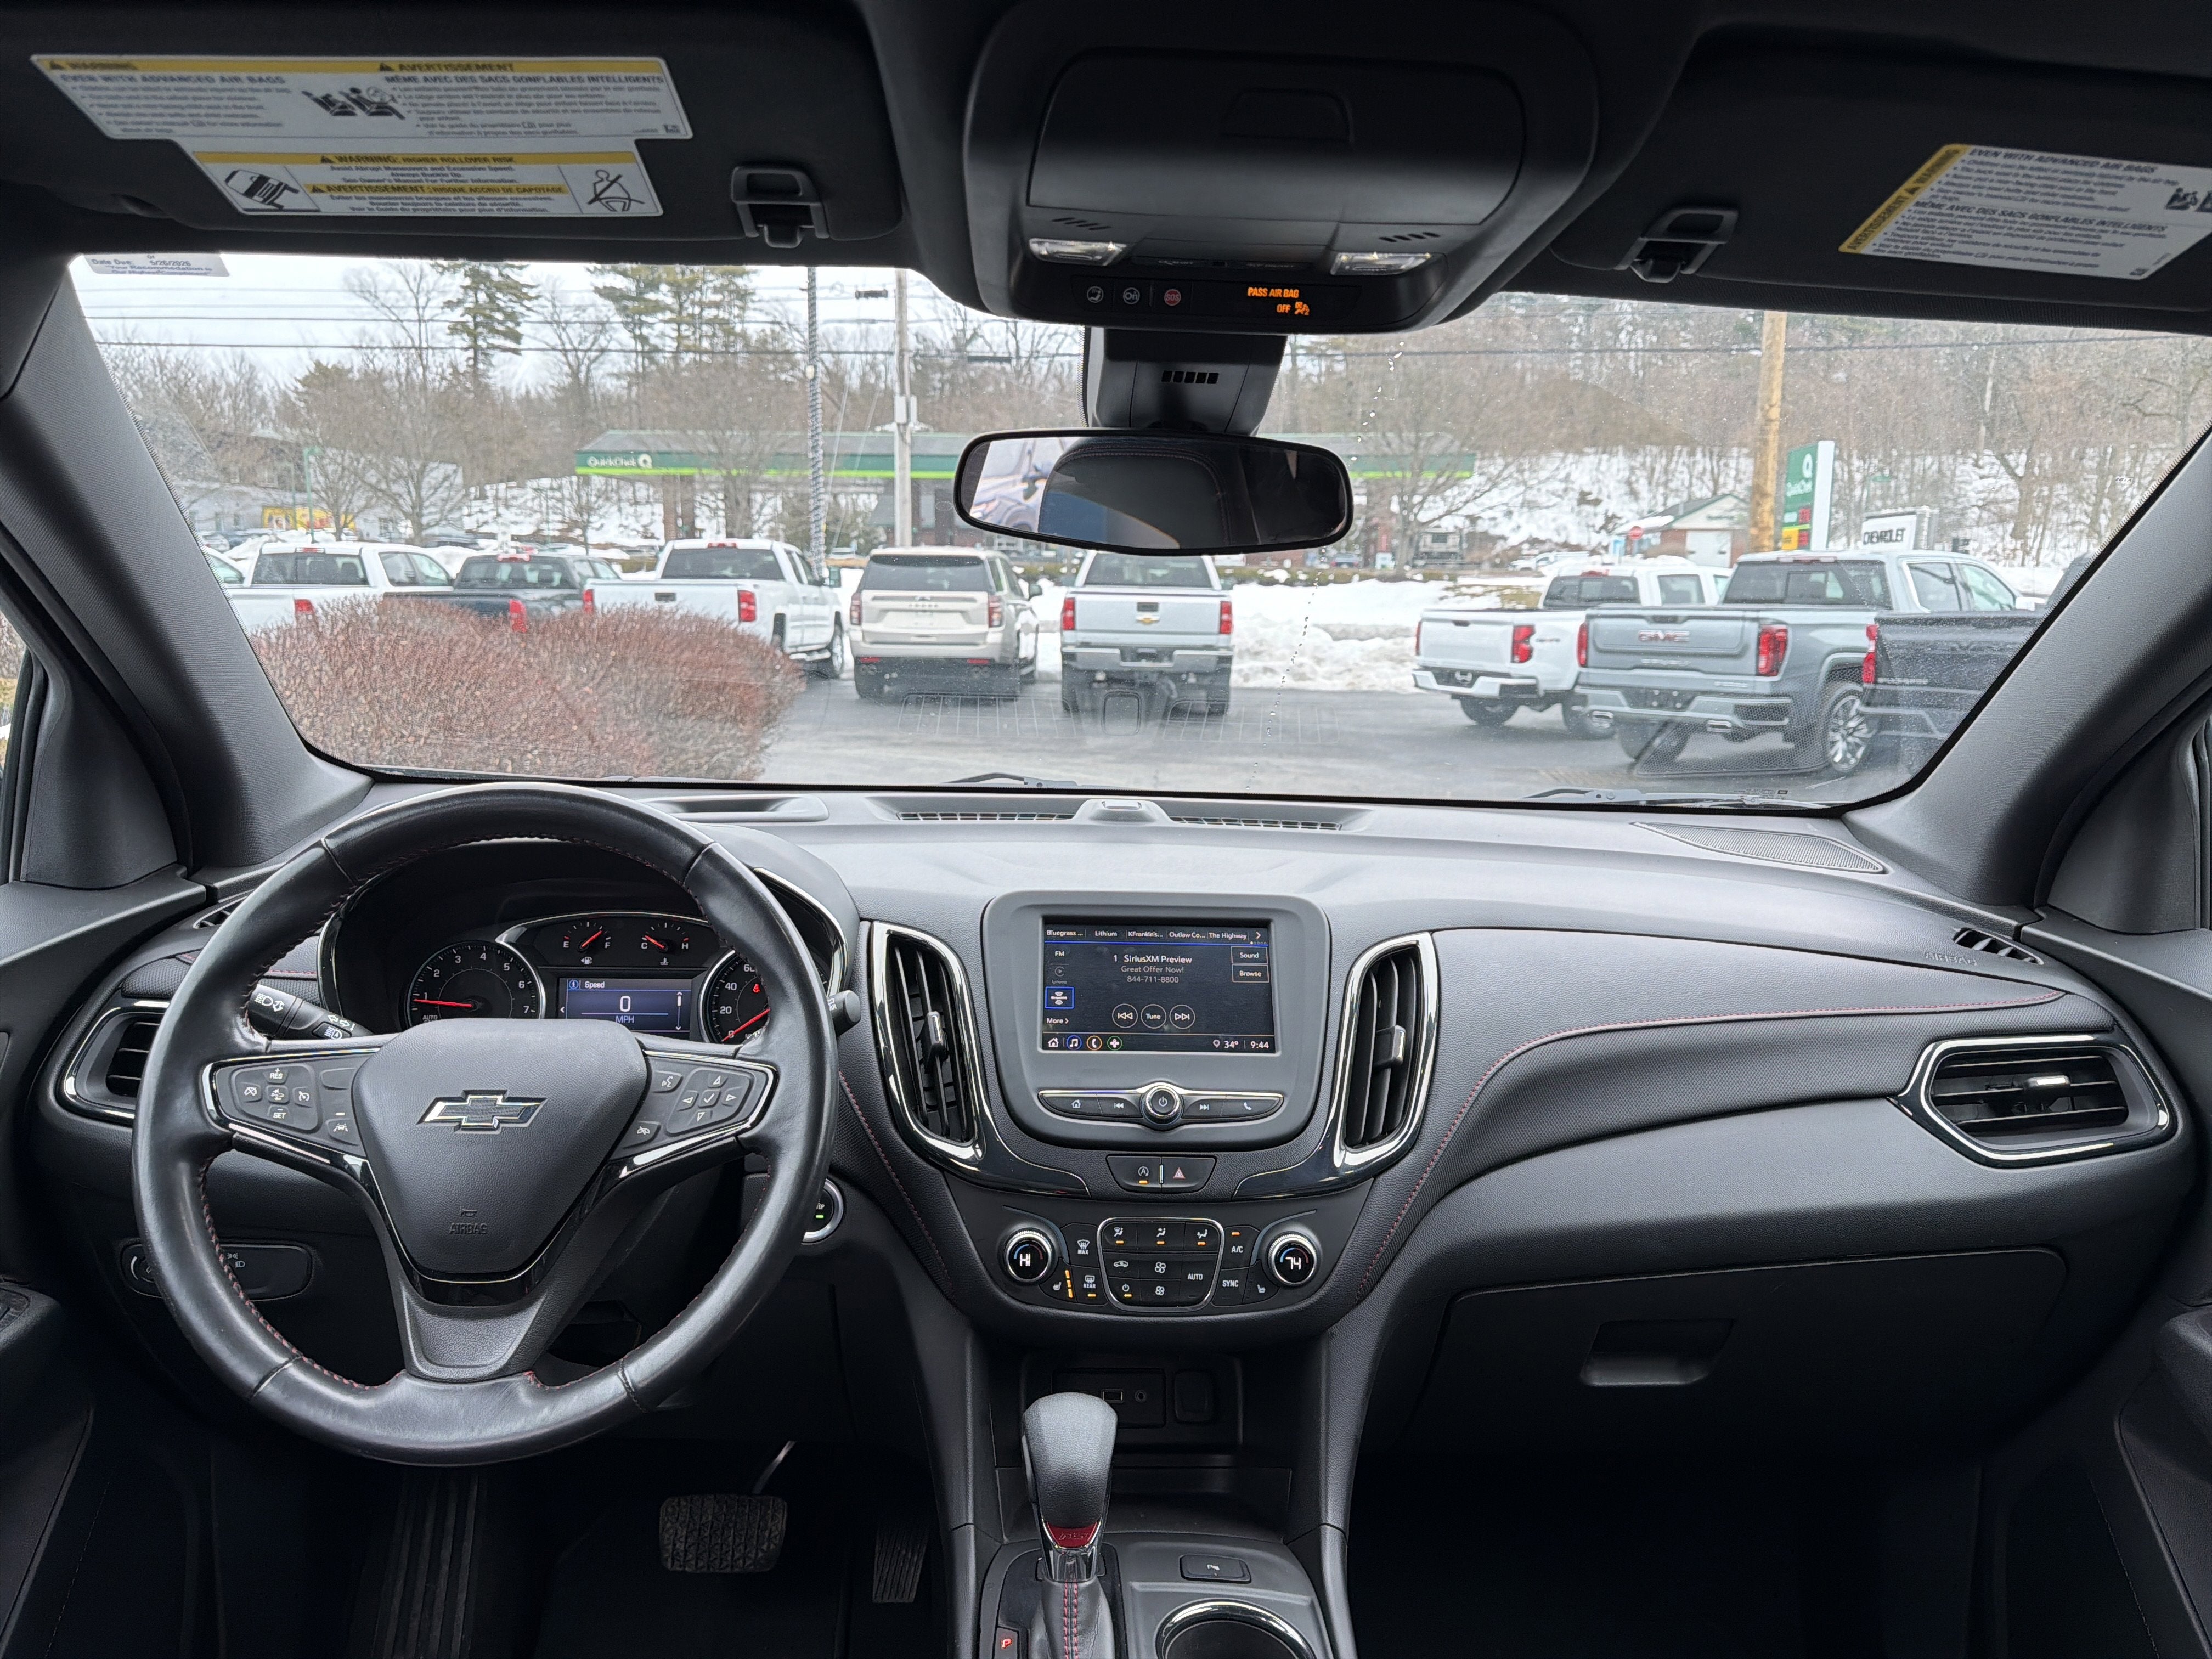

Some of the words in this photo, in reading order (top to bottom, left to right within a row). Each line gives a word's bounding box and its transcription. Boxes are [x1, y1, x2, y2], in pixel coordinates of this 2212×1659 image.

[1165, 293, 1181, 302] SOS
[1248, 287, 1268, 297] PASS
[1268, 288, 1283, 298] AIR
[1283, 289, 1300, 299] BAG
[1276, 303, 1291, 313] OFF
[455, 955, 461, 963] 3
[480, 952, 487, 961] 4
[1124, 954, 1159, 963] SiriusXM
[1161, 955, 1193, 963] Preview
[503, 963, 510, 971] 5
[1121, 965, 1142, 973] Great
[433, 969, 441, 978] 2
[518, 980, 526, 989] 6
[584, 981, 605, 989] Speed
[724, 982, 737, 991] 40
[424, 992, 428, 1000] 1
[620, 995, 631, 1012] 0
[523, 1005, 530, 1014] 7
[719, 1006, 732, 1014] 20
[616, 1015, 635, 1024] MPH
[1223, 1040, 1239, 1049] 34°
[1250, 1041, 1270, 1049] 9:44
[448, 1222, 489, 1235] AIRBAG
[1231, 1245, 1244, 1254] A/C
[1019, 1253, 1031, 1267] HI
[1285, 1256, 1301, 1271] 74
[1222, 1279, 1239, 1288] SYNC
[1001, 1638, 1013, 1649] P
